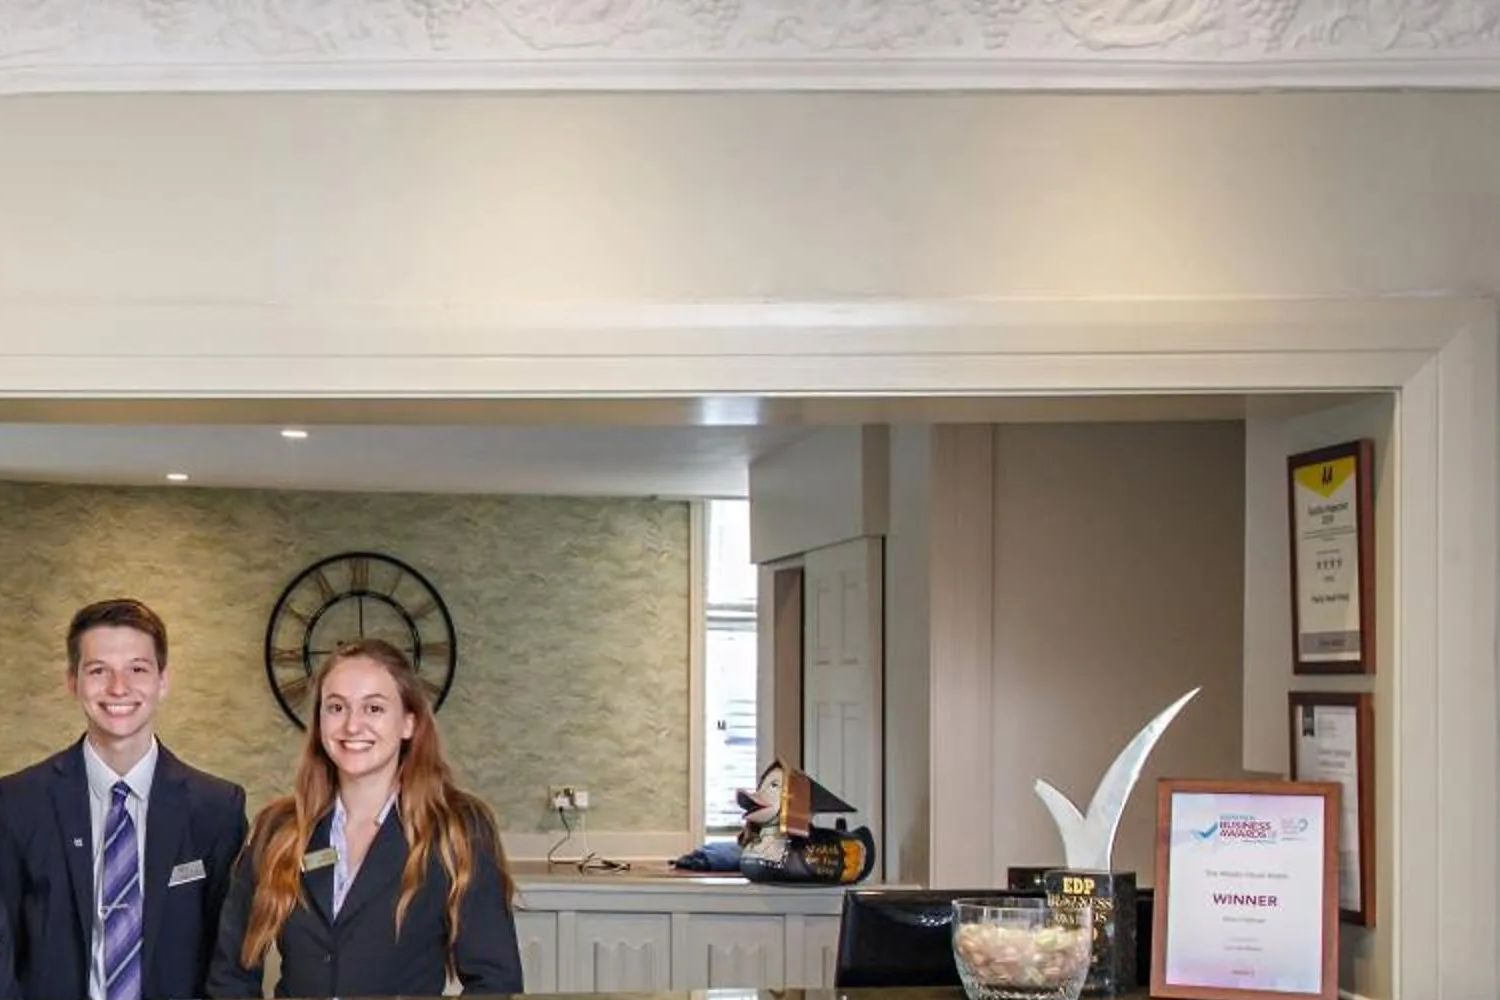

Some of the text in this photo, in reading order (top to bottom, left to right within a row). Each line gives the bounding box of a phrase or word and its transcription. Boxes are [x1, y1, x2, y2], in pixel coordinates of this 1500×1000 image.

[1219, 821, 1271, 831] BUSINESS
[1063, 877, 1094, 895] EDP
[1213, 893, 1277, 907] WINNER
